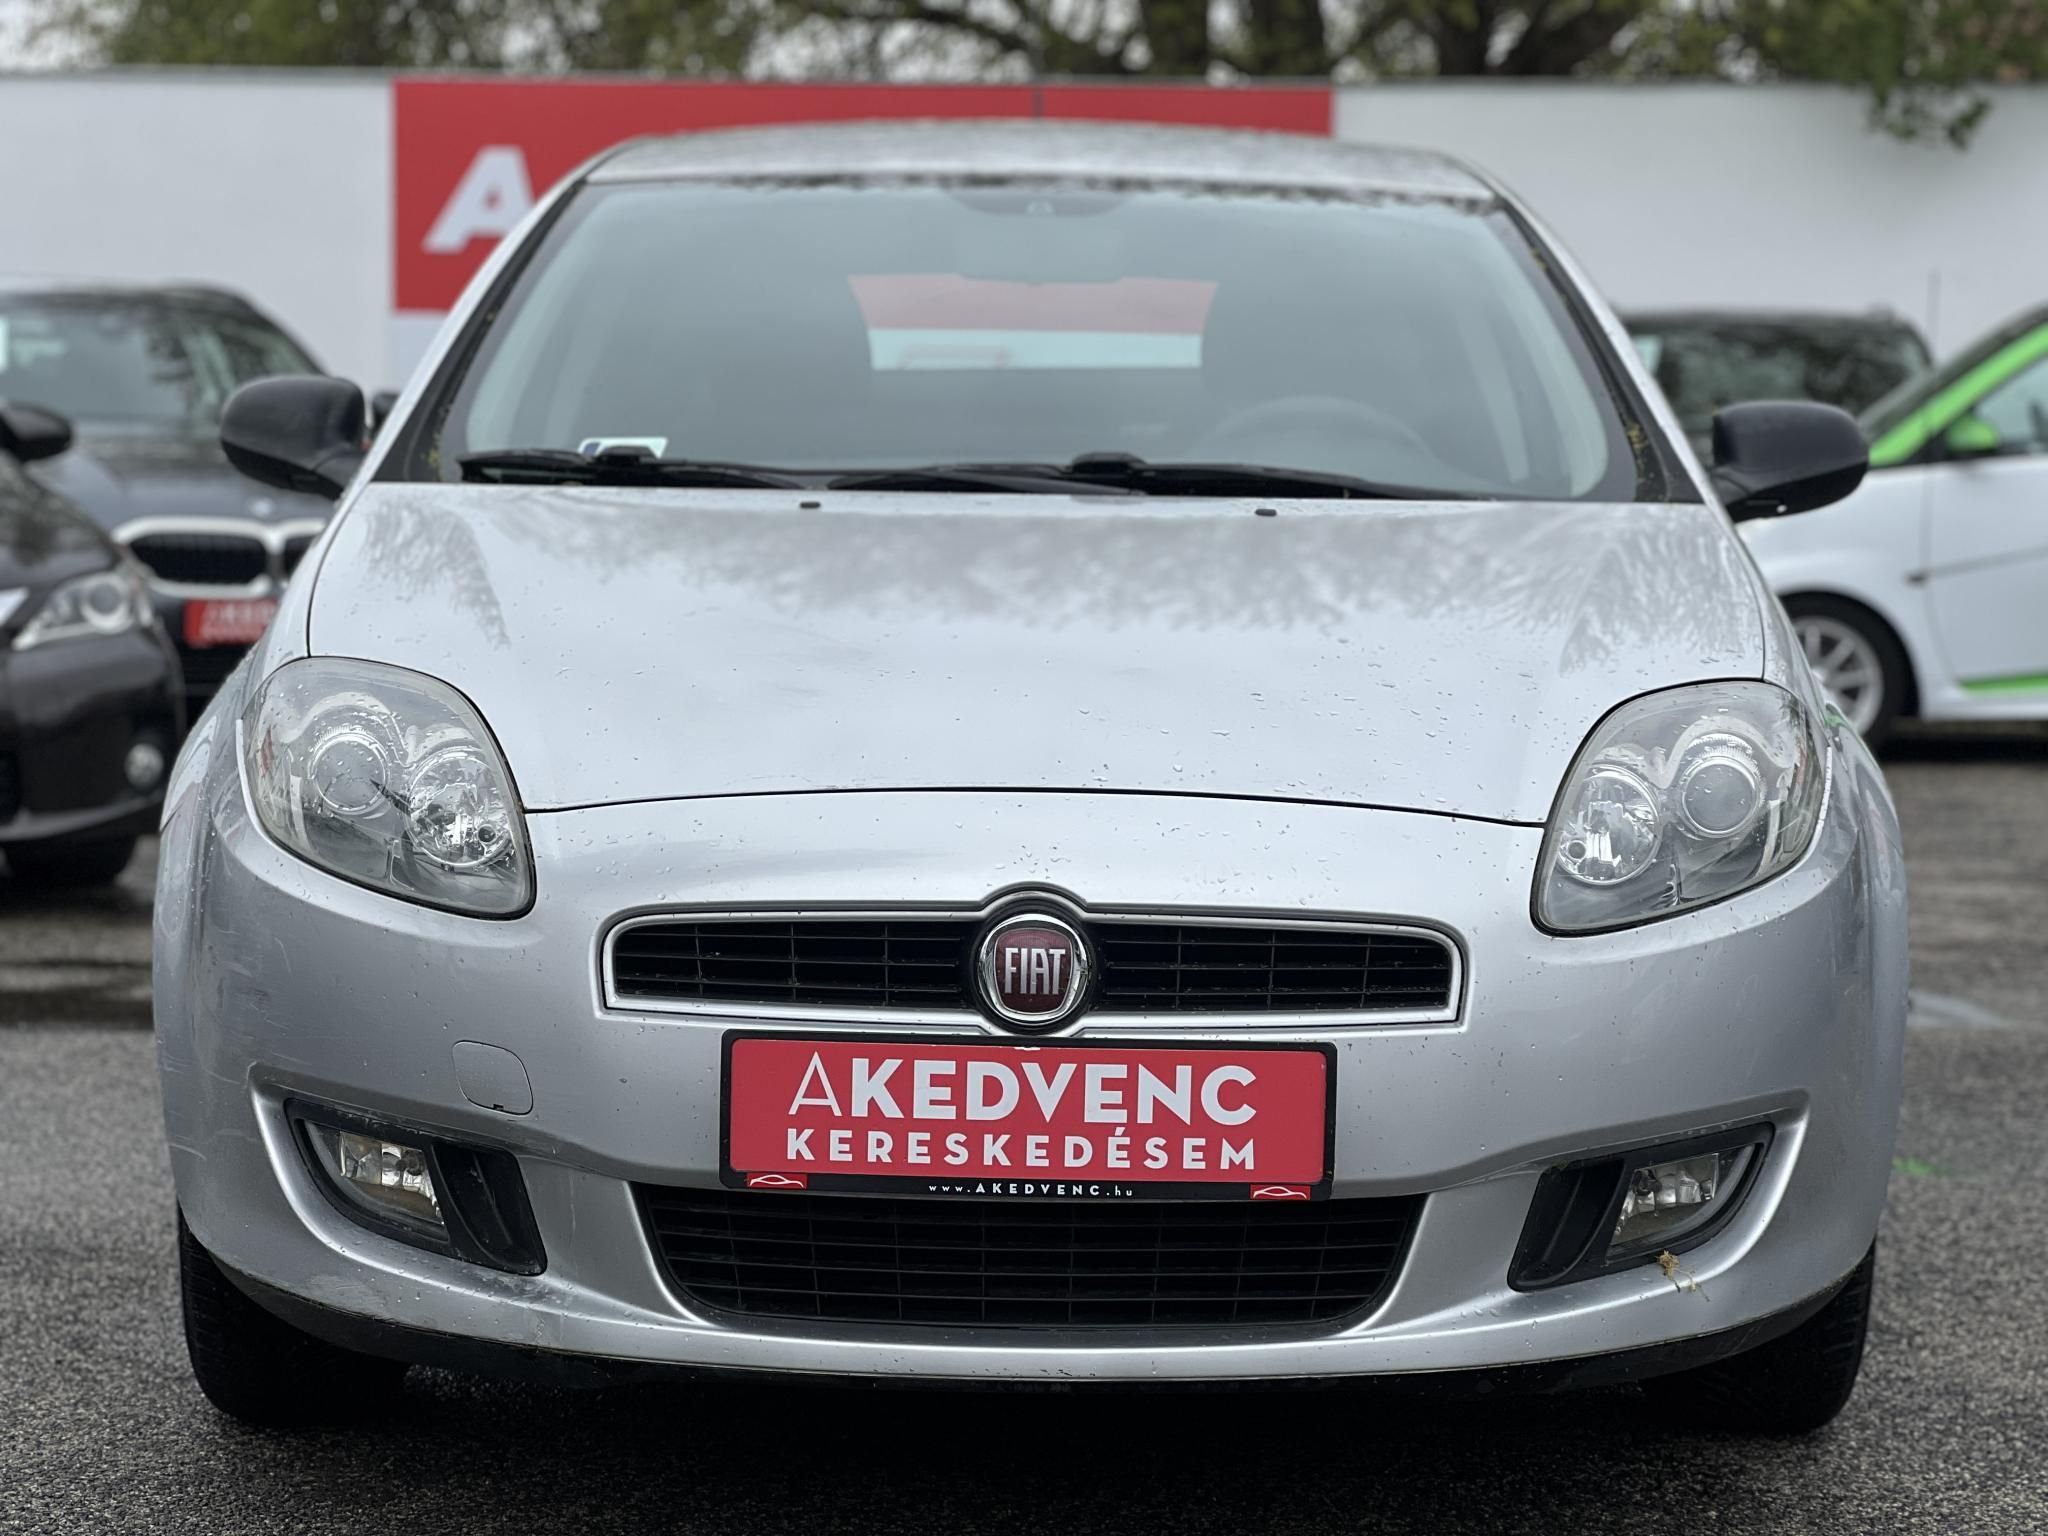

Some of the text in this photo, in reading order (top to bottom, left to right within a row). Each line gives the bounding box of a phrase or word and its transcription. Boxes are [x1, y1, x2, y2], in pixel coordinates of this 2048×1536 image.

[1004, 947, 1066, 995] FIAT
[787, 1127, 1256, 1170] KERESKEDÉSEM
[928, 1182, 1133, 1197] www.AKEDVENC.hu
